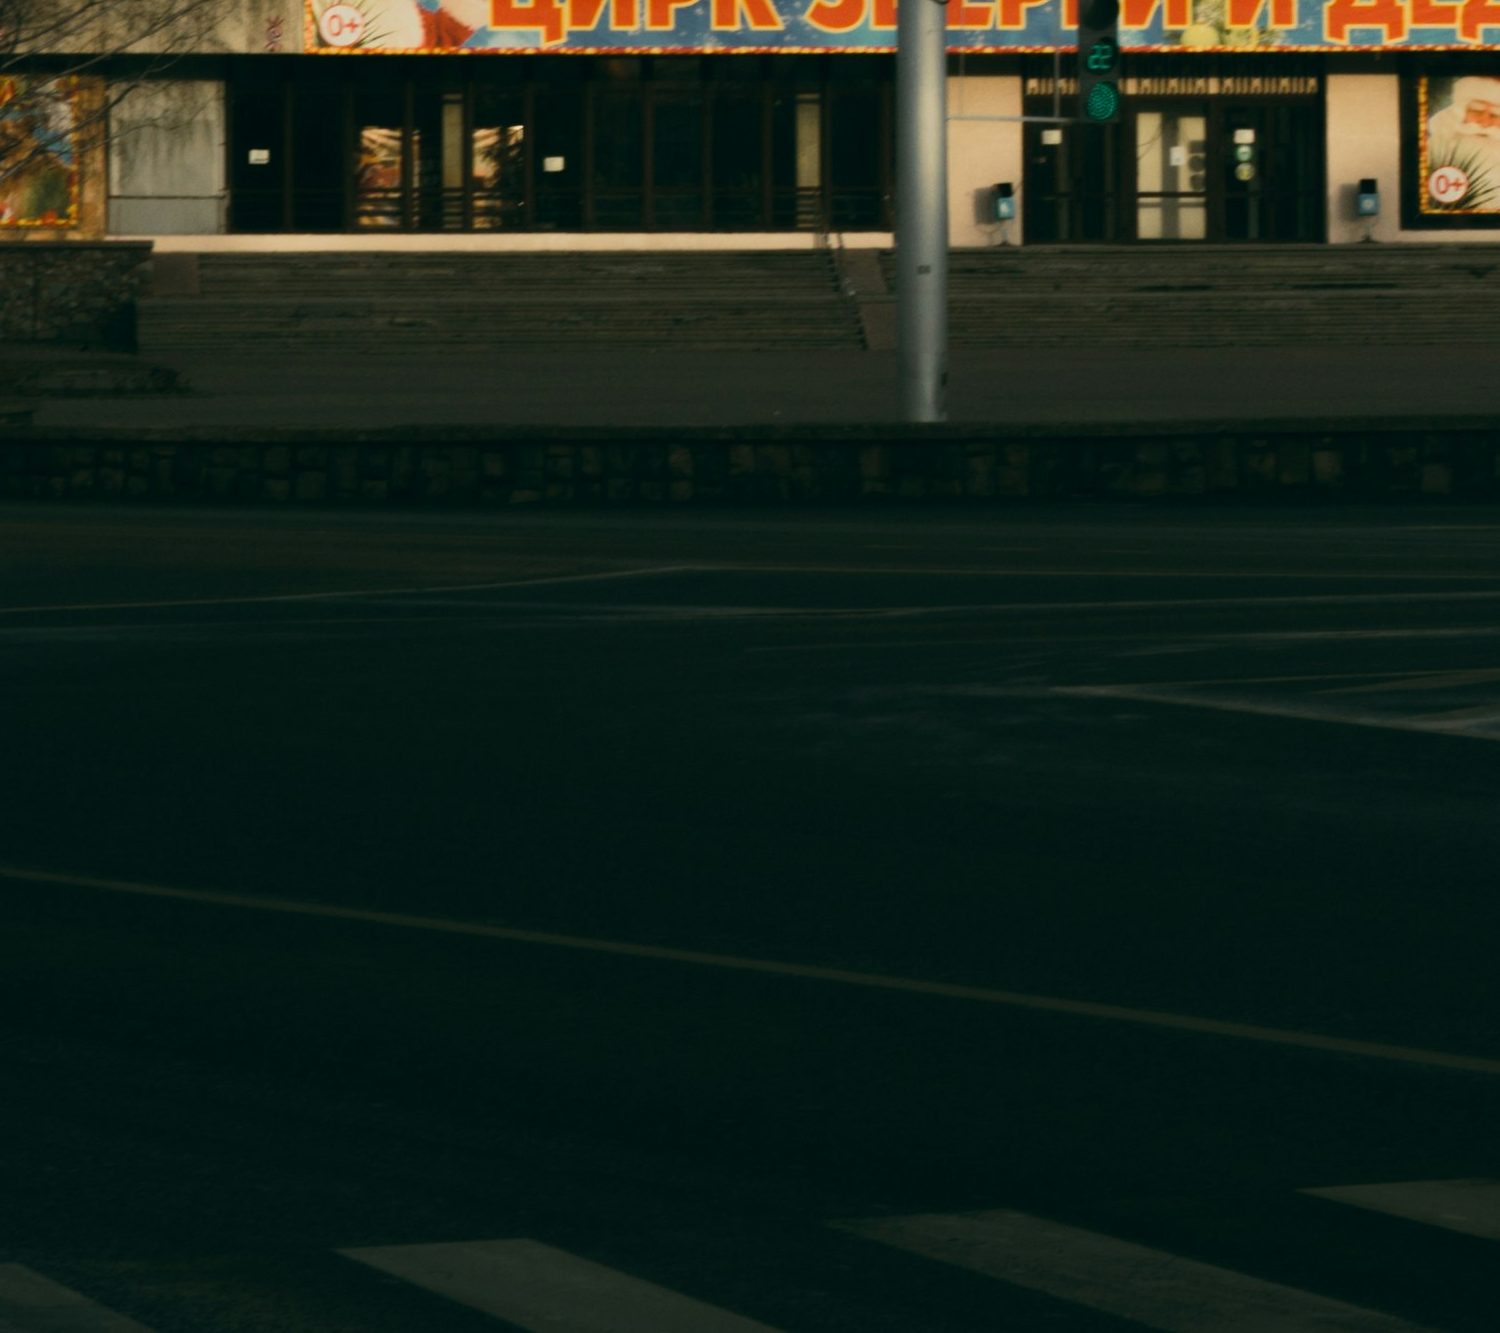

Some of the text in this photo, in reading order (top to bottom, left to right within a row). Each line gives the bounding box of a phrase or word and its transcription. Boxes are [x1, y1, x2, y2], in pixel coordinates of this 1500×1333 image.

[327, 14, 360, 37] 0+
[1086, 44, 1114, 70] 22
[1434, 174, 1464, 195] 0+
